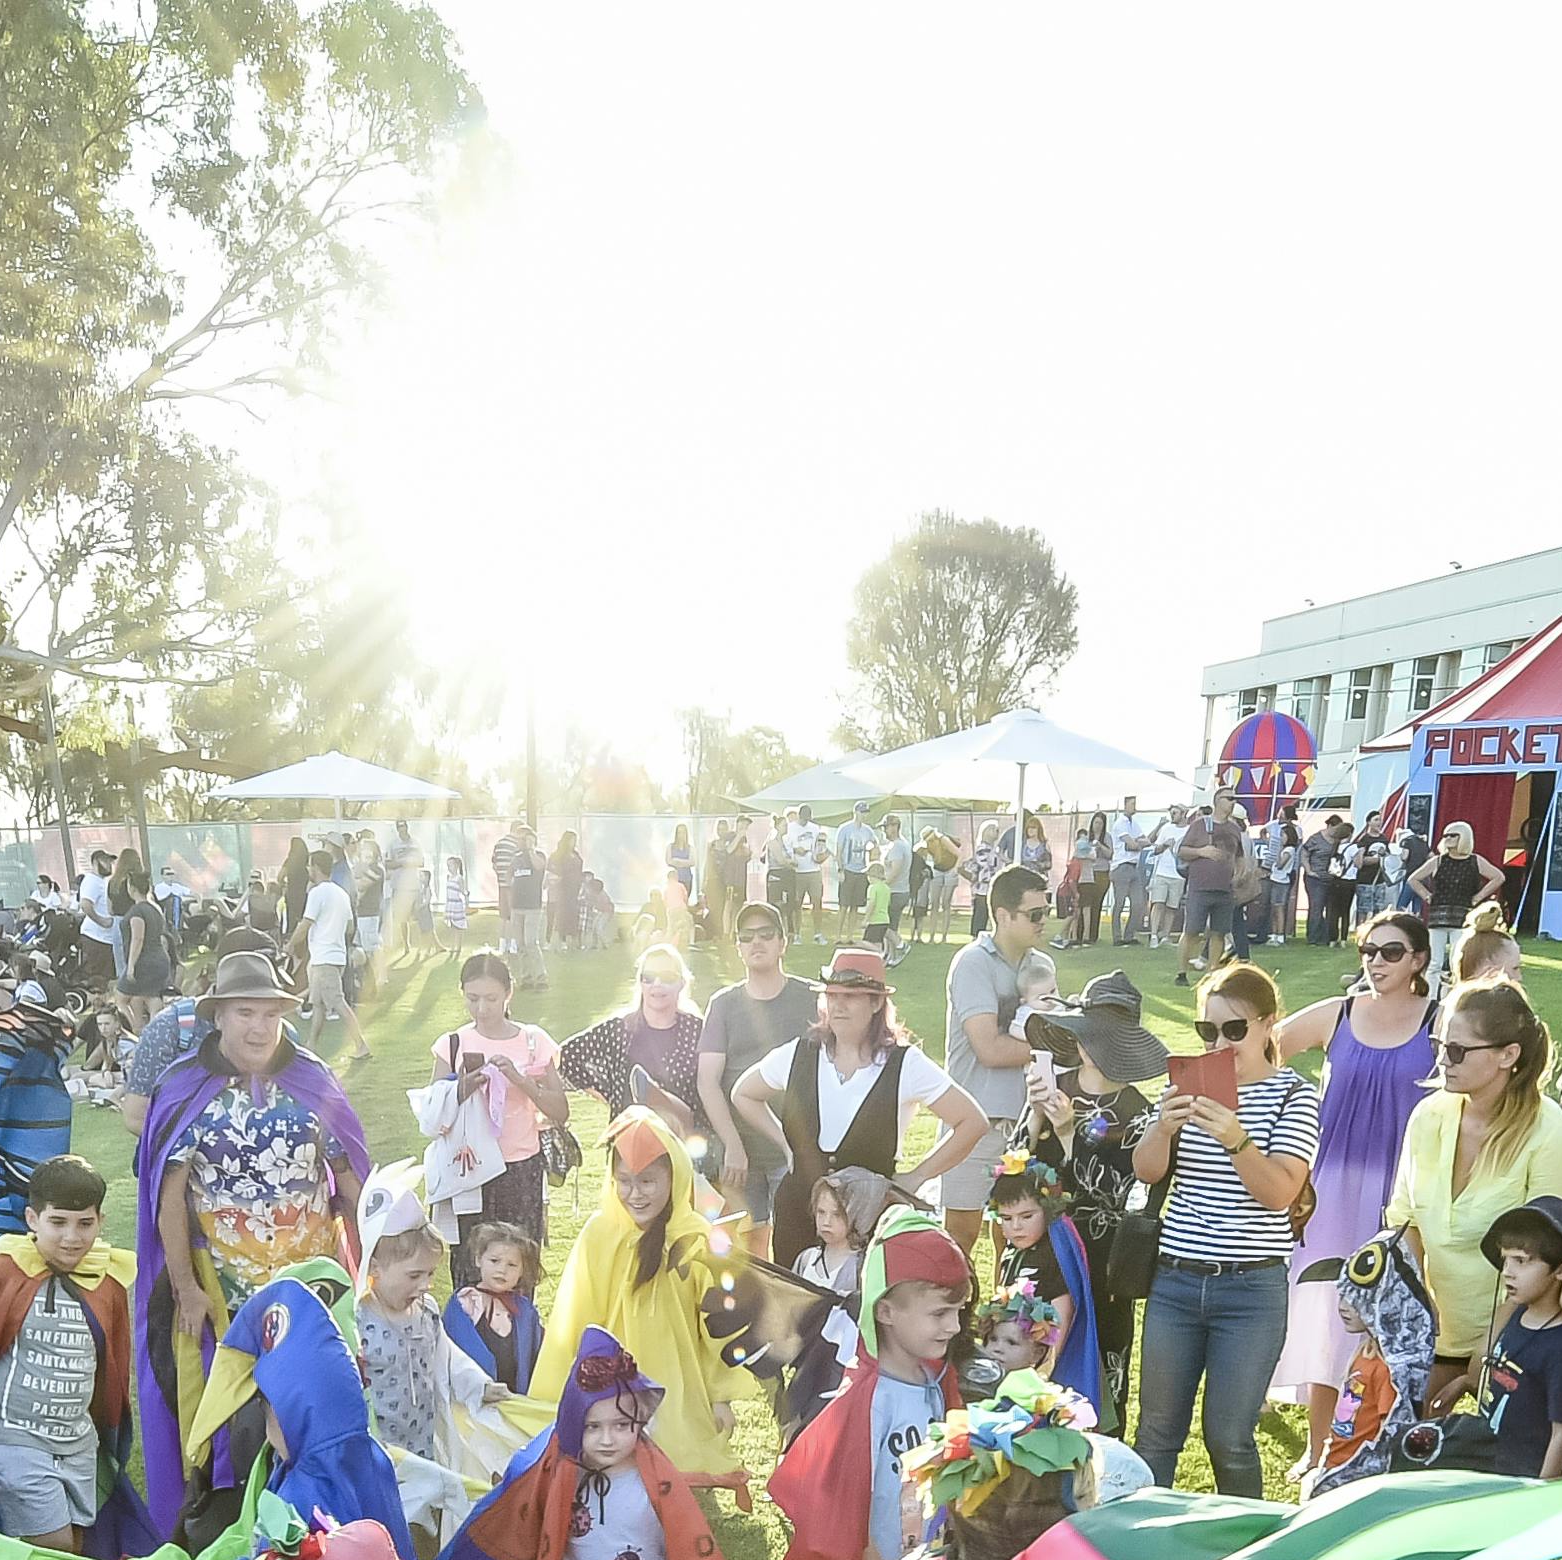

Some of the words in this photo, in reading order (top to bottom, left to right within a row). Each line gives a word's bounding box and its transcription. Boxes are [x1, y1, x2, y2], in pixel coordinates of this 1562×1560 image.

[25, 1328, 52, 1342] SAN
[26, 1350, 67, 1369] SANTA
[22, 1373, 77, 1394] BEVERLY
